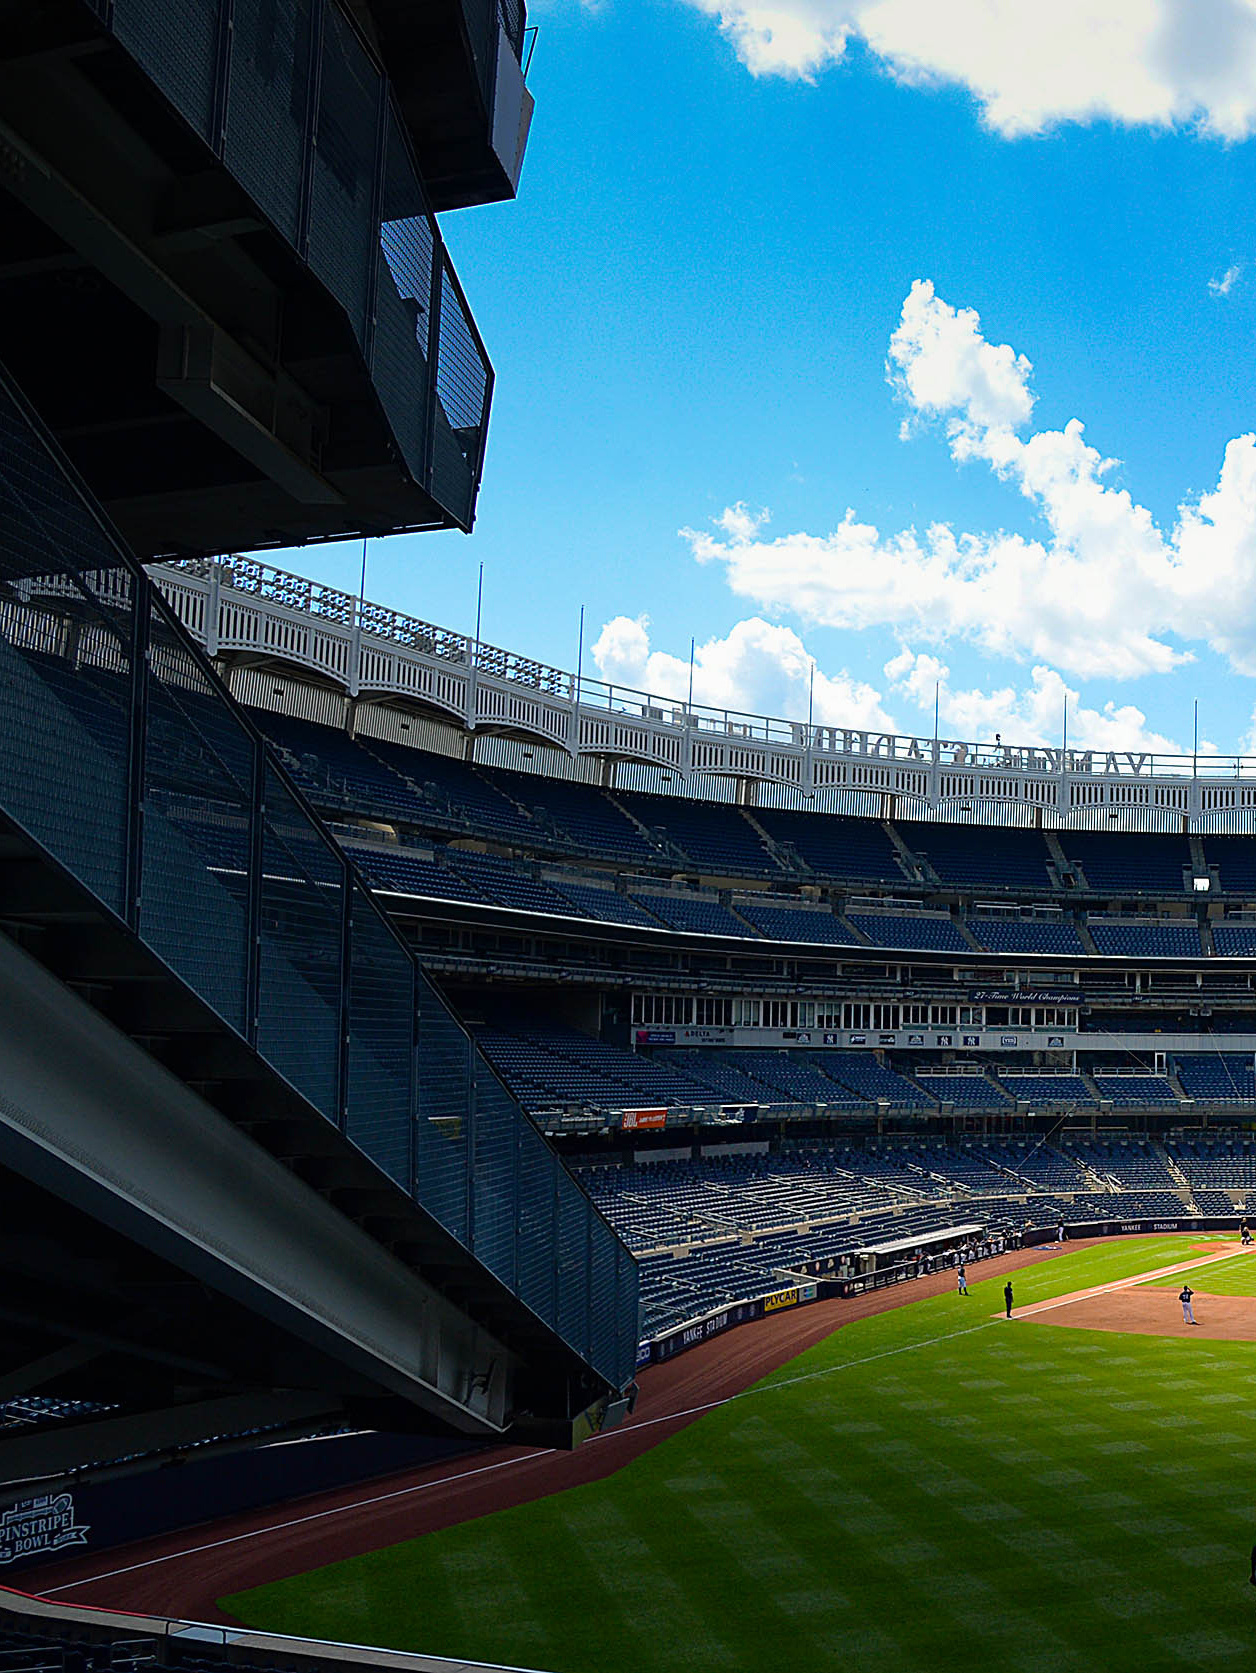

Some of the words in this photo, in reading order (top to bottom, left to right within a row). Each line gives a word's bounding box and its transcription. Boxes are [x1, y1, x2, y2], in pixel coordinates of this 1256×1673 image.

[974, 991, 1008, 1000] 27-Time
[1011, 992, 1037, 1000] World
[1038, 992, 1079, 1003] Champions
[624, 1112, 637, 1128] JBL
[765, 1290, 796, 1306] PLYCAR
[683, 1325, 703, 1345] YANKEE
[15, 1533, 51, 1552] BOWL
